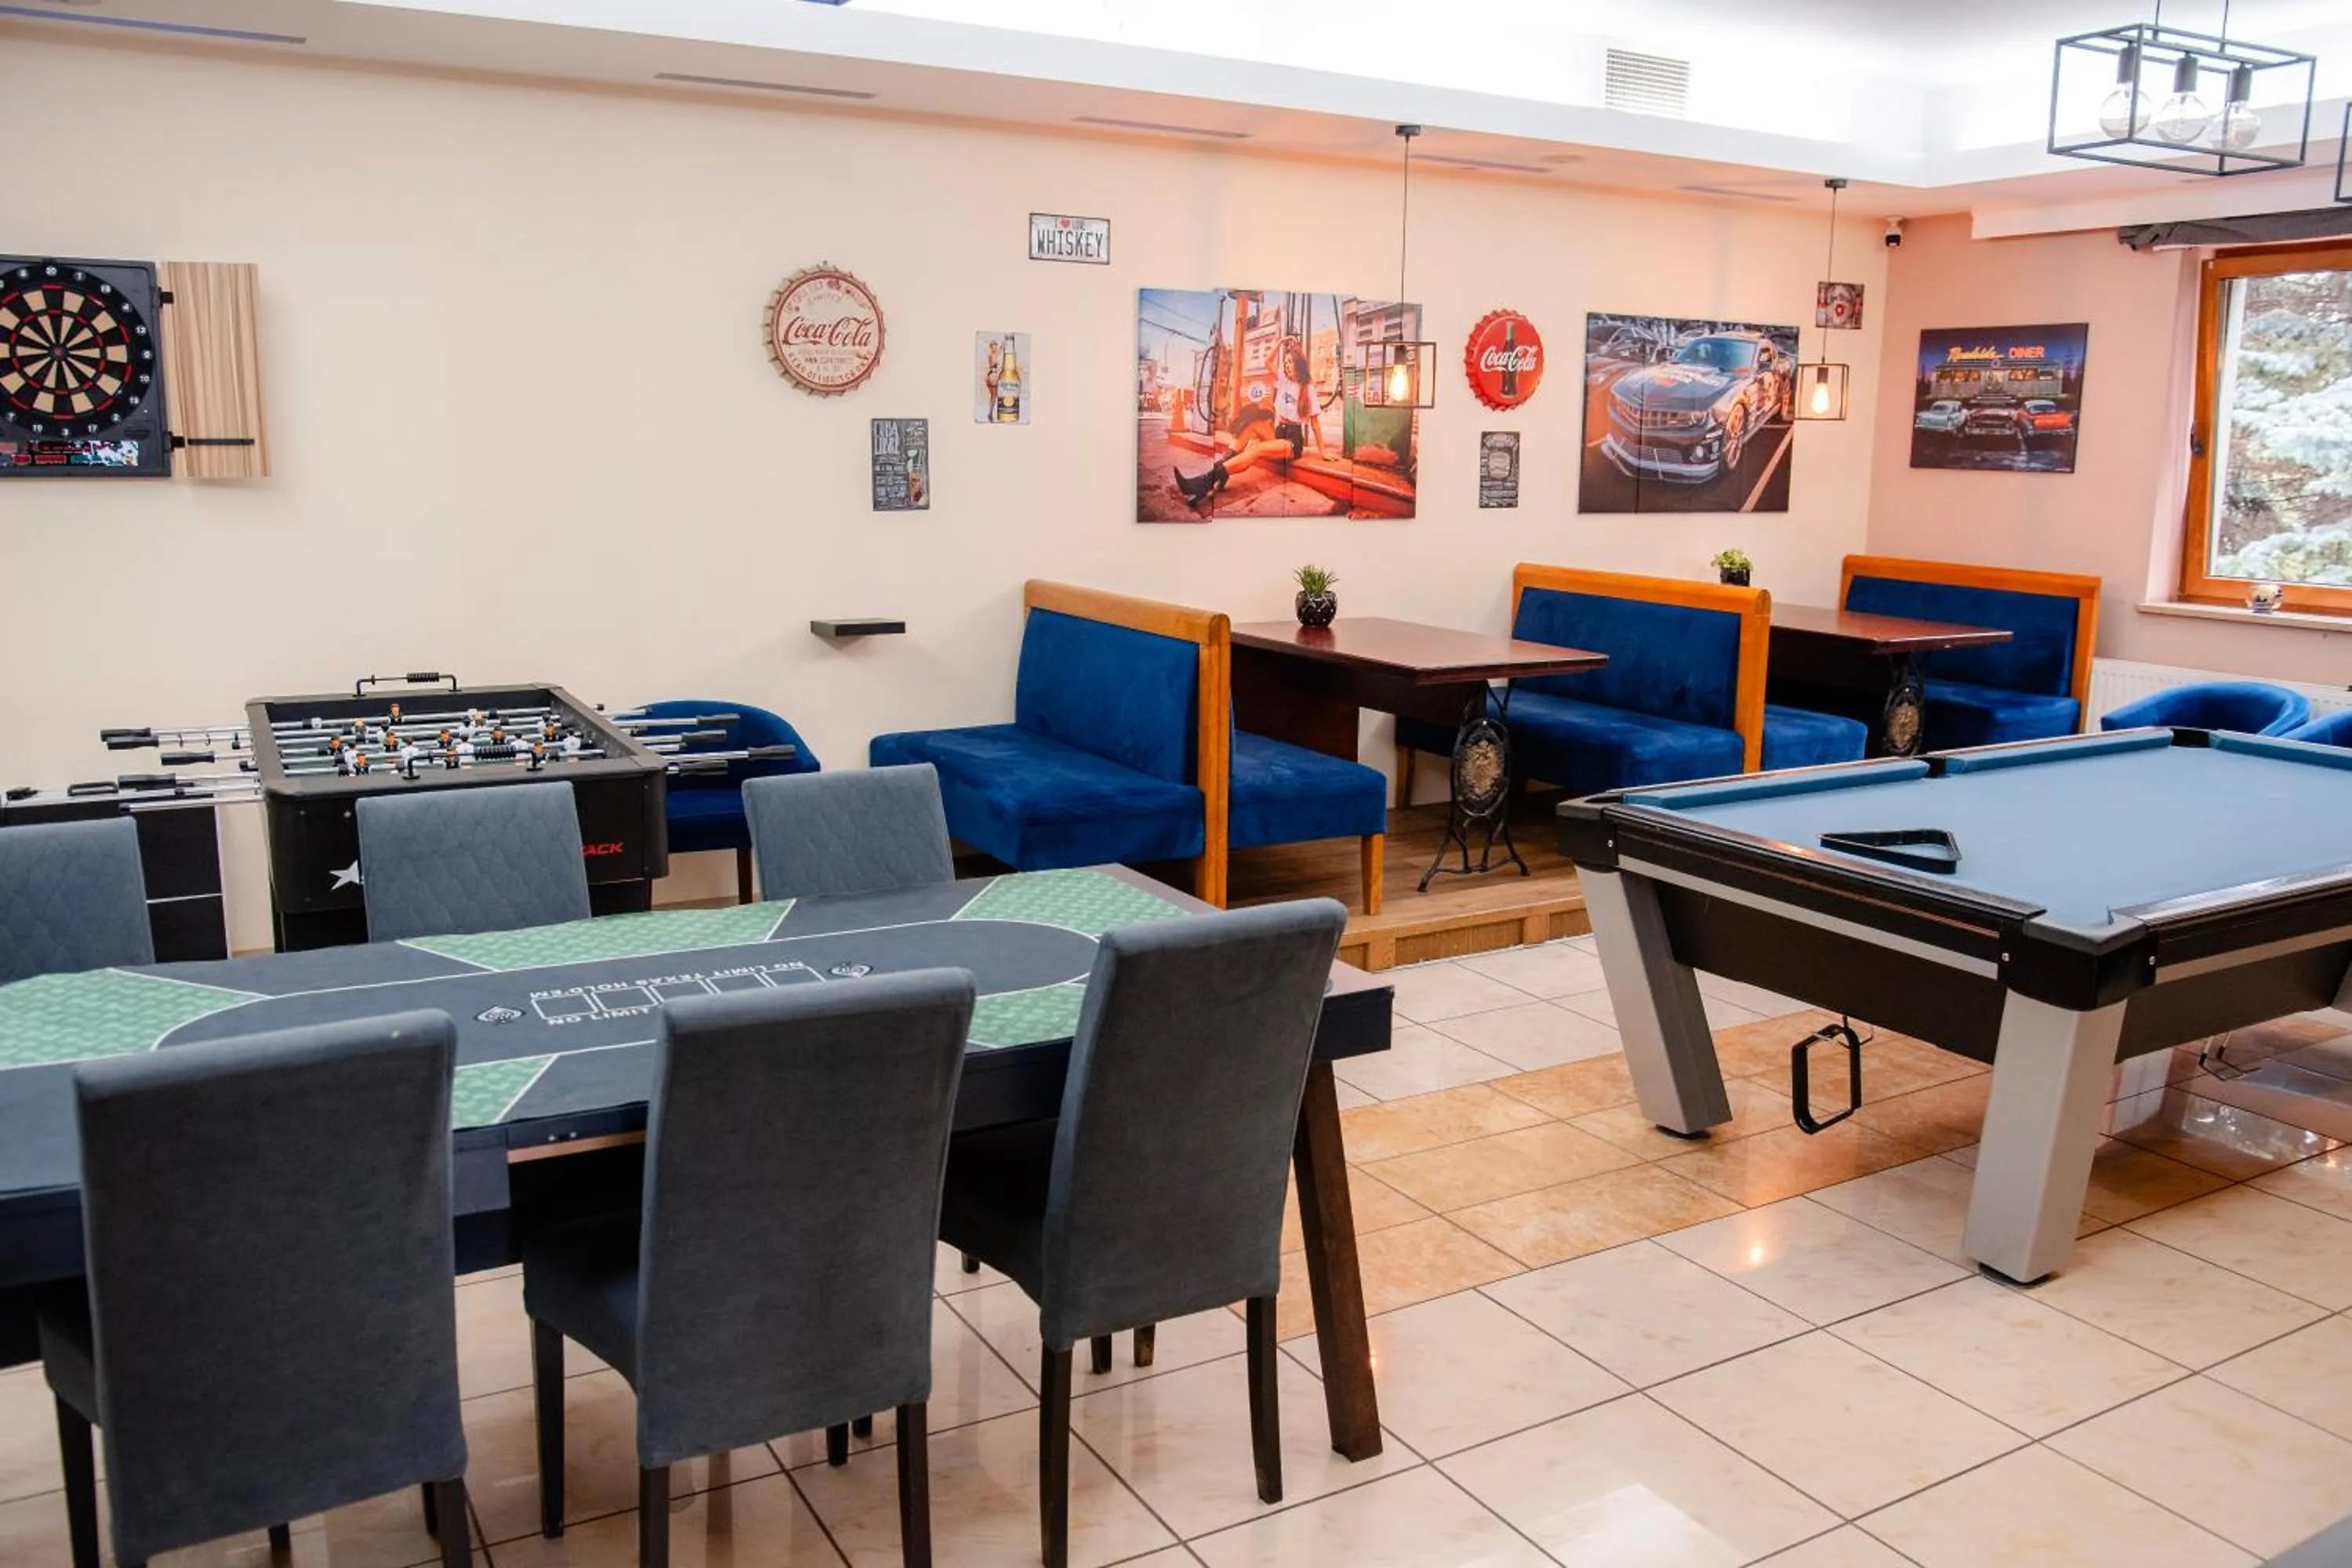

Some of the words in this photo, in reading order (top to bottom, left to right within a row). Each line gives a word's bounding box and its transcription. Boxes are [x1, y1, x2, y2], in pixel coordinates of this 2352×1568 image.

[1037, 229, 1103, 258] WHISKEY
[1480, 345, 1539, 372] Coca-Cola
[2009, 345, 2045, 359] DINER
[580, 842, 624, 856] ACK
[713, 965, 767, 976] LIMIT
[634, 972, 705, 985] TEXAS
[548, 1015, 582, 1025] NO
[590, 1007, 650, 1020] LIMIT
